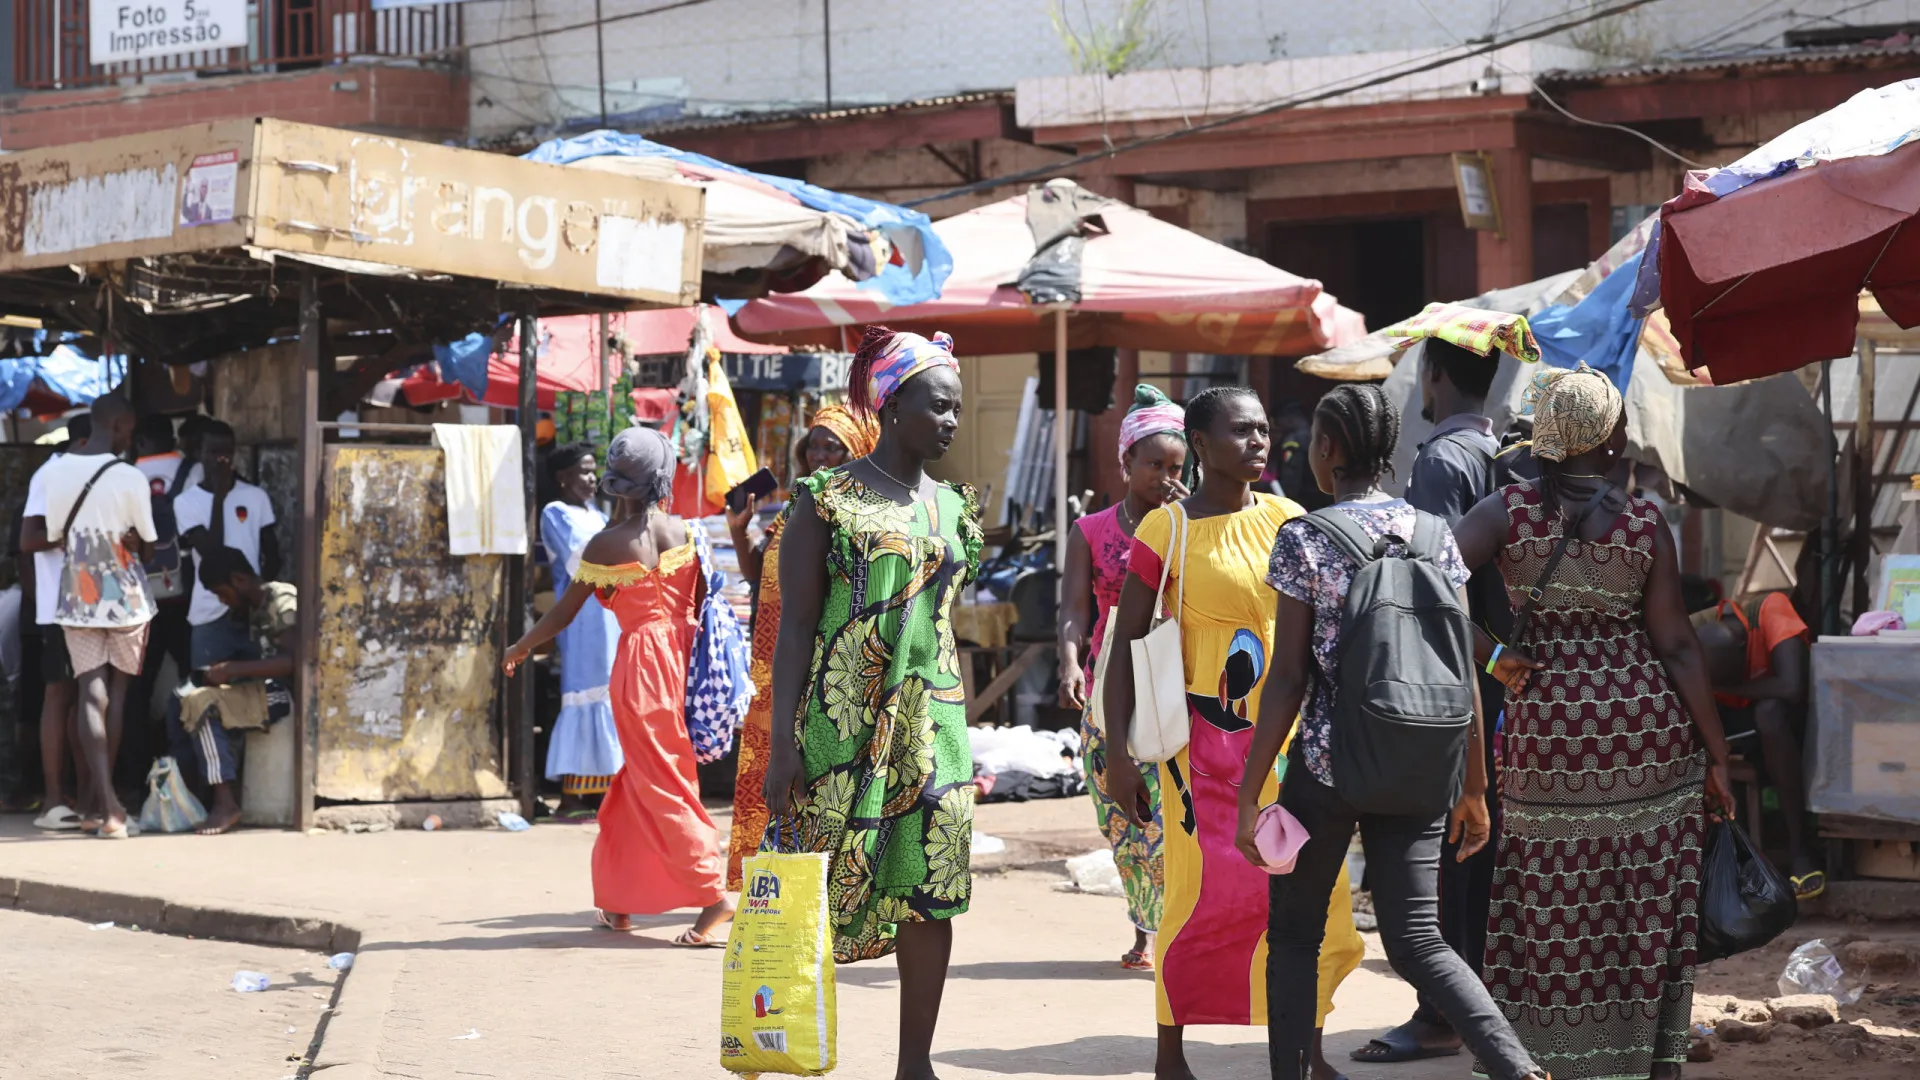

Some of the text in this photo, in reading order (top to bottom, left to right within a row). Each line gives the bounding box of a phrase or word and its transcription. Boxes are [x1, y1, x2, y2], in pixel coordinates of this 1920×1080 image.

[118, 0, 196, 28] Foto 5
[110, 19, 221, 54] Impressão
